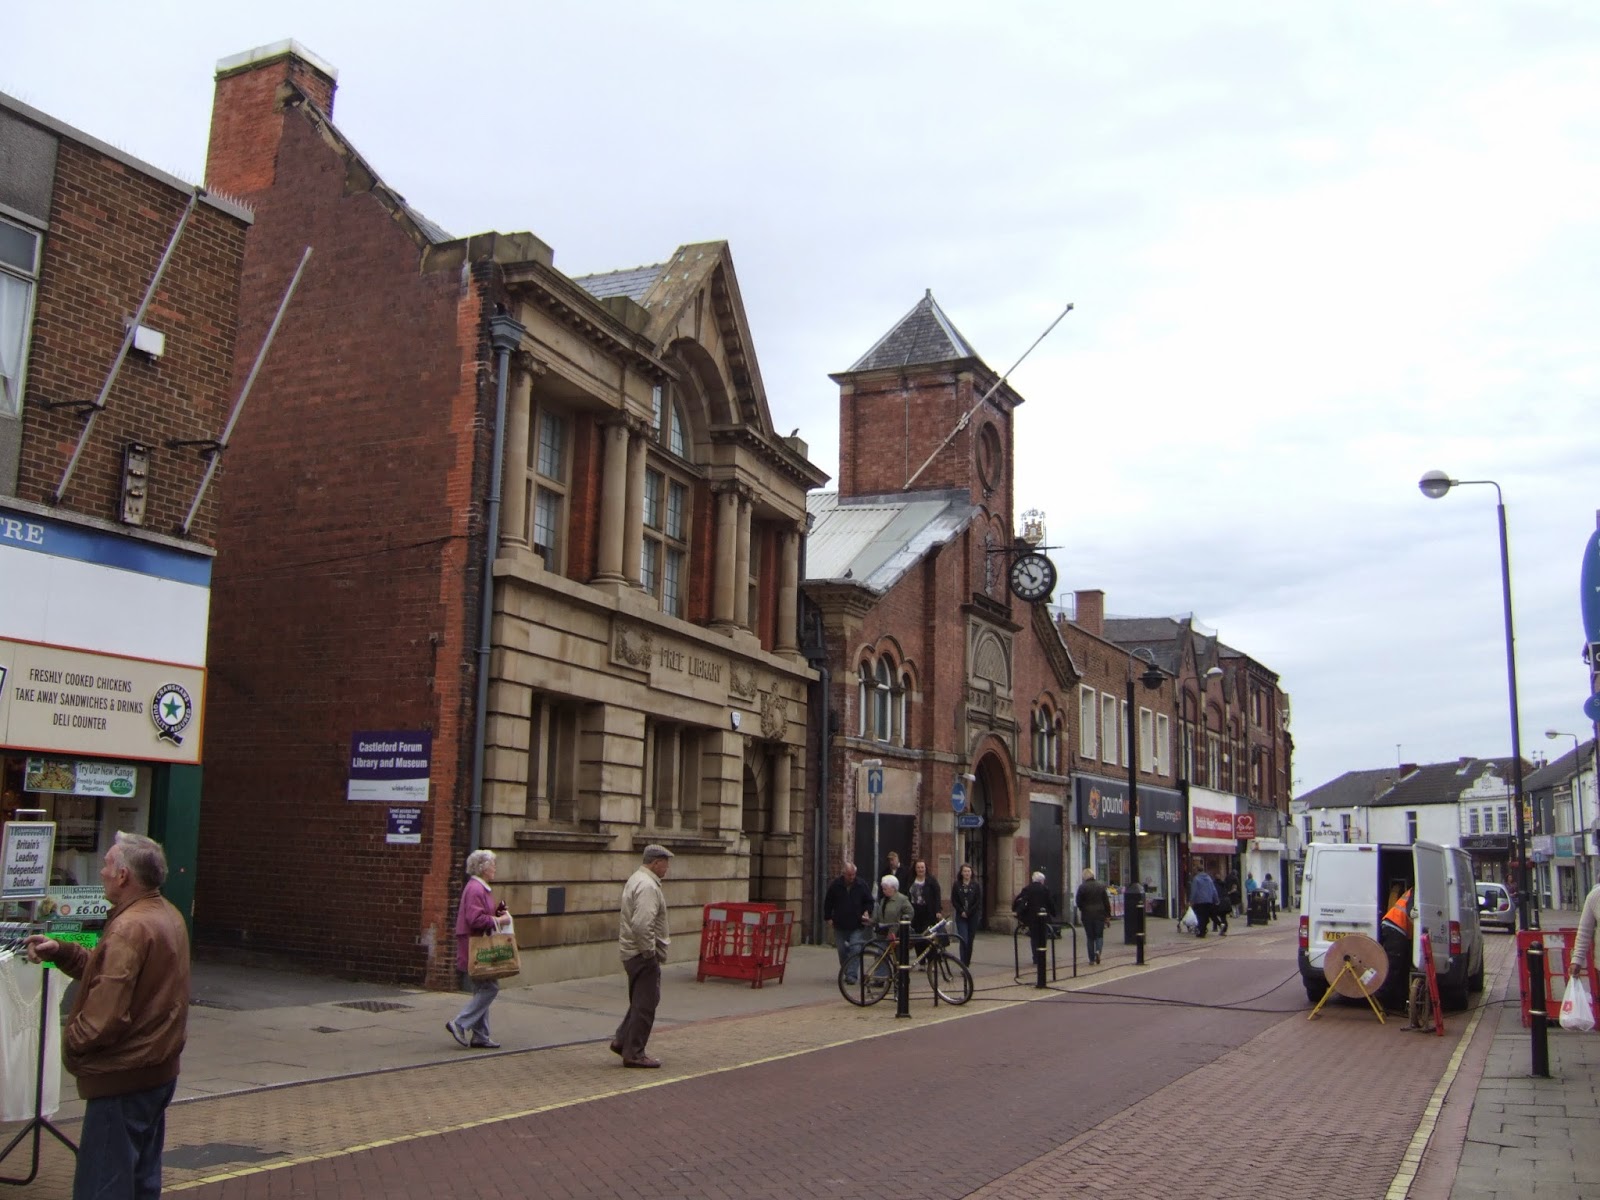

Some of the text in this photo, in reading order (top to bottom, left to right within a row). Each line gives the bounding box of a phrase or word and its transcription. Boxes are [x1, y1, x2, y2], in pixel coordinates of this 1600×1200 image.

[660, 647, 722, 683] FREE LIBRARY
[29, 668, 132, 693] FRESHLY COOKED CHICKENS
[156, 685, 190, 702] CRAWSHAWS
[15, 687, 143, 714] TAKE AWAY SANDWICHES & DRINKS
[52, 713, 107, 730] DELI COUNTER
[359, 742, 422, 752] Castleford Forum
[352, 758, 428, 770] Library and Museum
[16, 839, 40, 850] Britain's
[15, 851, 39, 865] Leading
[6, 864, 44, 877] Independent
[12, 876, 36, 888] Butcher
[76, 905, 107, 915] £6.00
[51, 923, 79, 931] AWSHAWS
